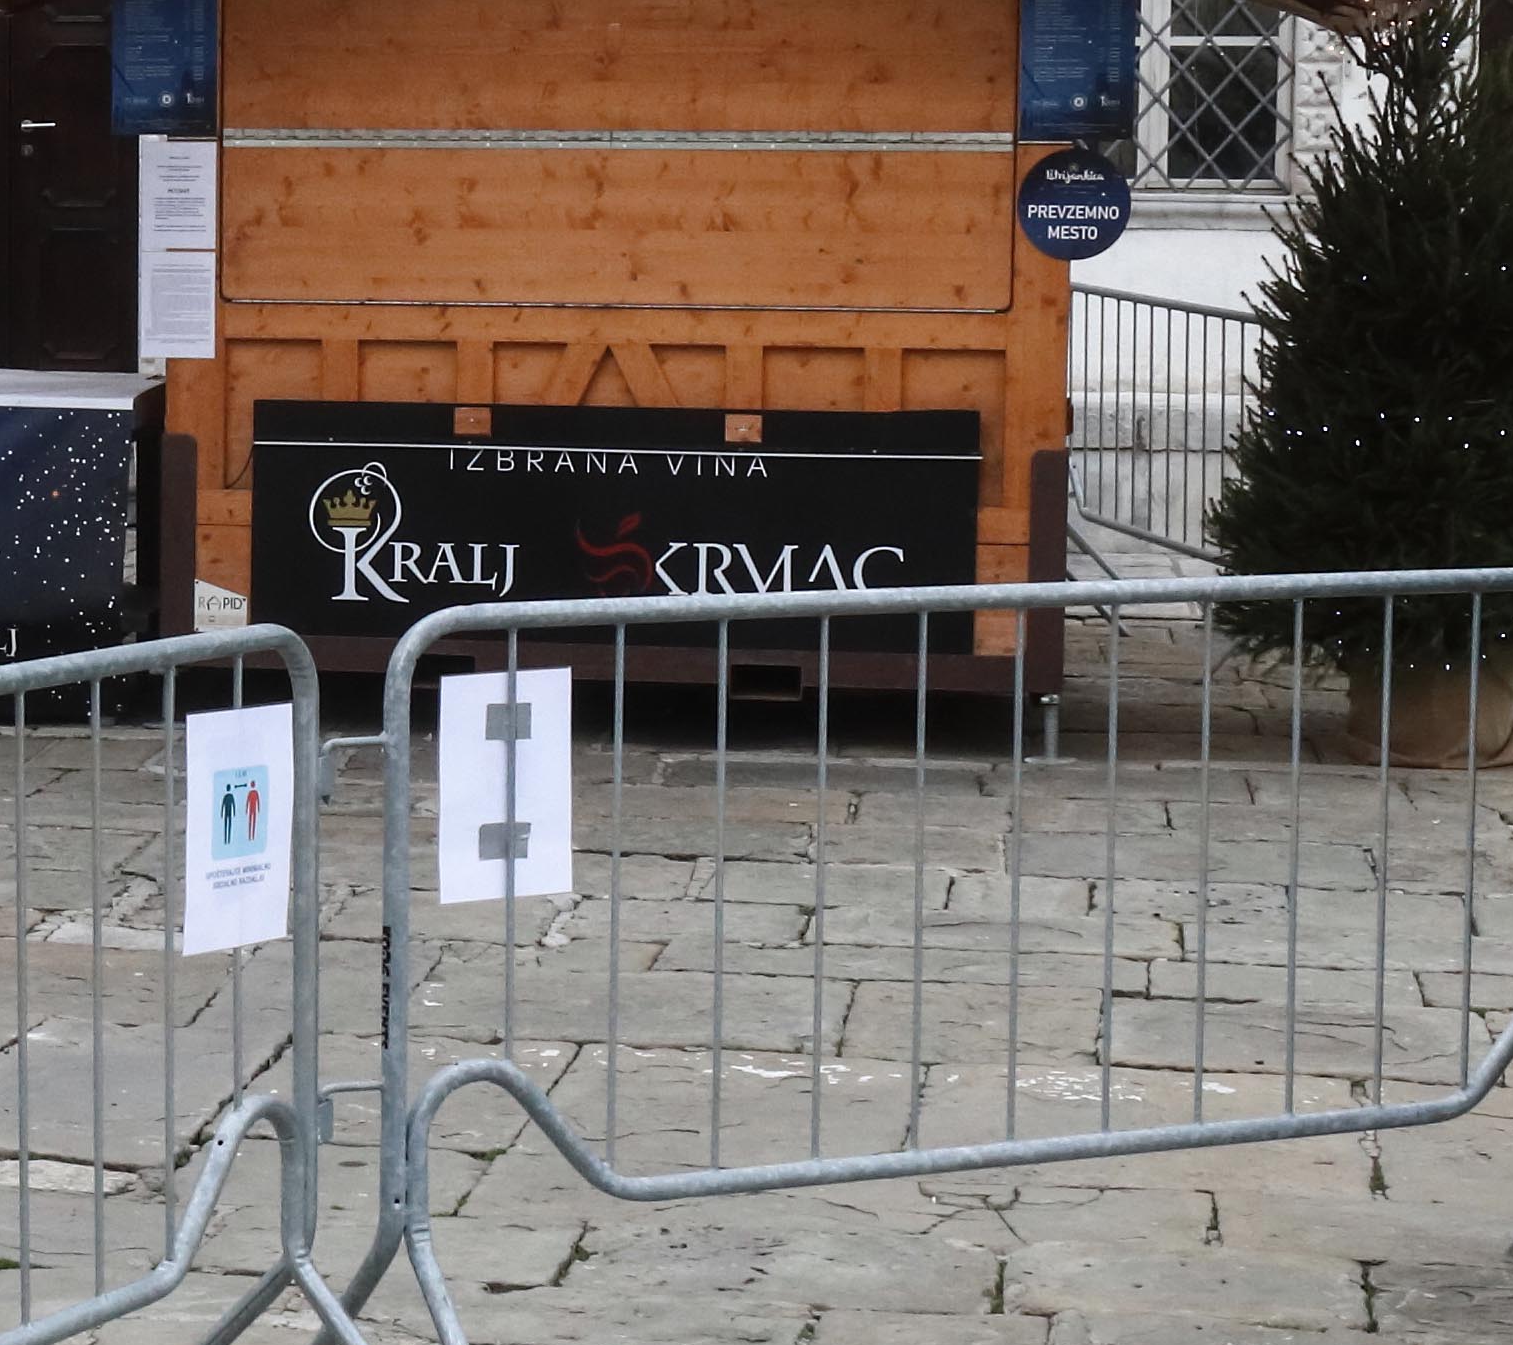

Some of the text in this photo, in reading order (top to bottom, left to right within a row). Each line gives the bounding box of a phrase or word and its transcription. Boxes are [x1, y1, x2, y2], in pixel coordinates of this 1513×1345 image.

[1027, 204, 1120, 220] PREVZEMNO
[1047, 225, 1098, 240] MESTO
[448, 447, 768, 478] IZBRANA VINA
